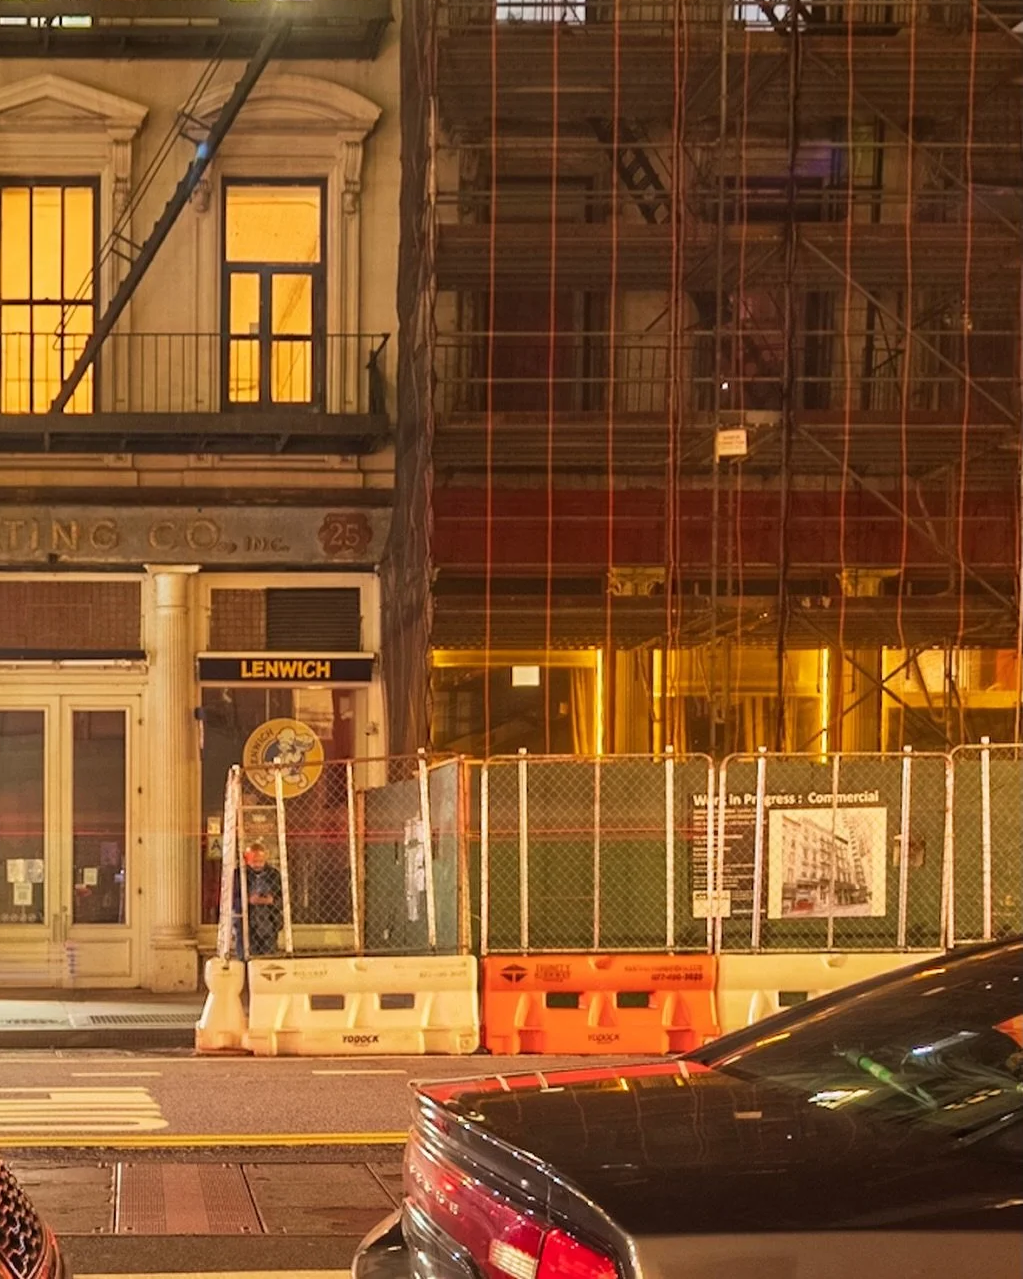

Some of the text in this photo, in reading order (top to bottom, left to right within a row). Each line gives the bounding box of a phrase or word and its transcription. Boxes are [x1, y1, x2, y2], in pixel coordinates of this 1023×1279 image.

[328, 522, 360, 547] 25
[240, 660, 331, 679] LENWICH
[729, 793, 742, 805] in
[744, 793, 795, 807] Prgress
